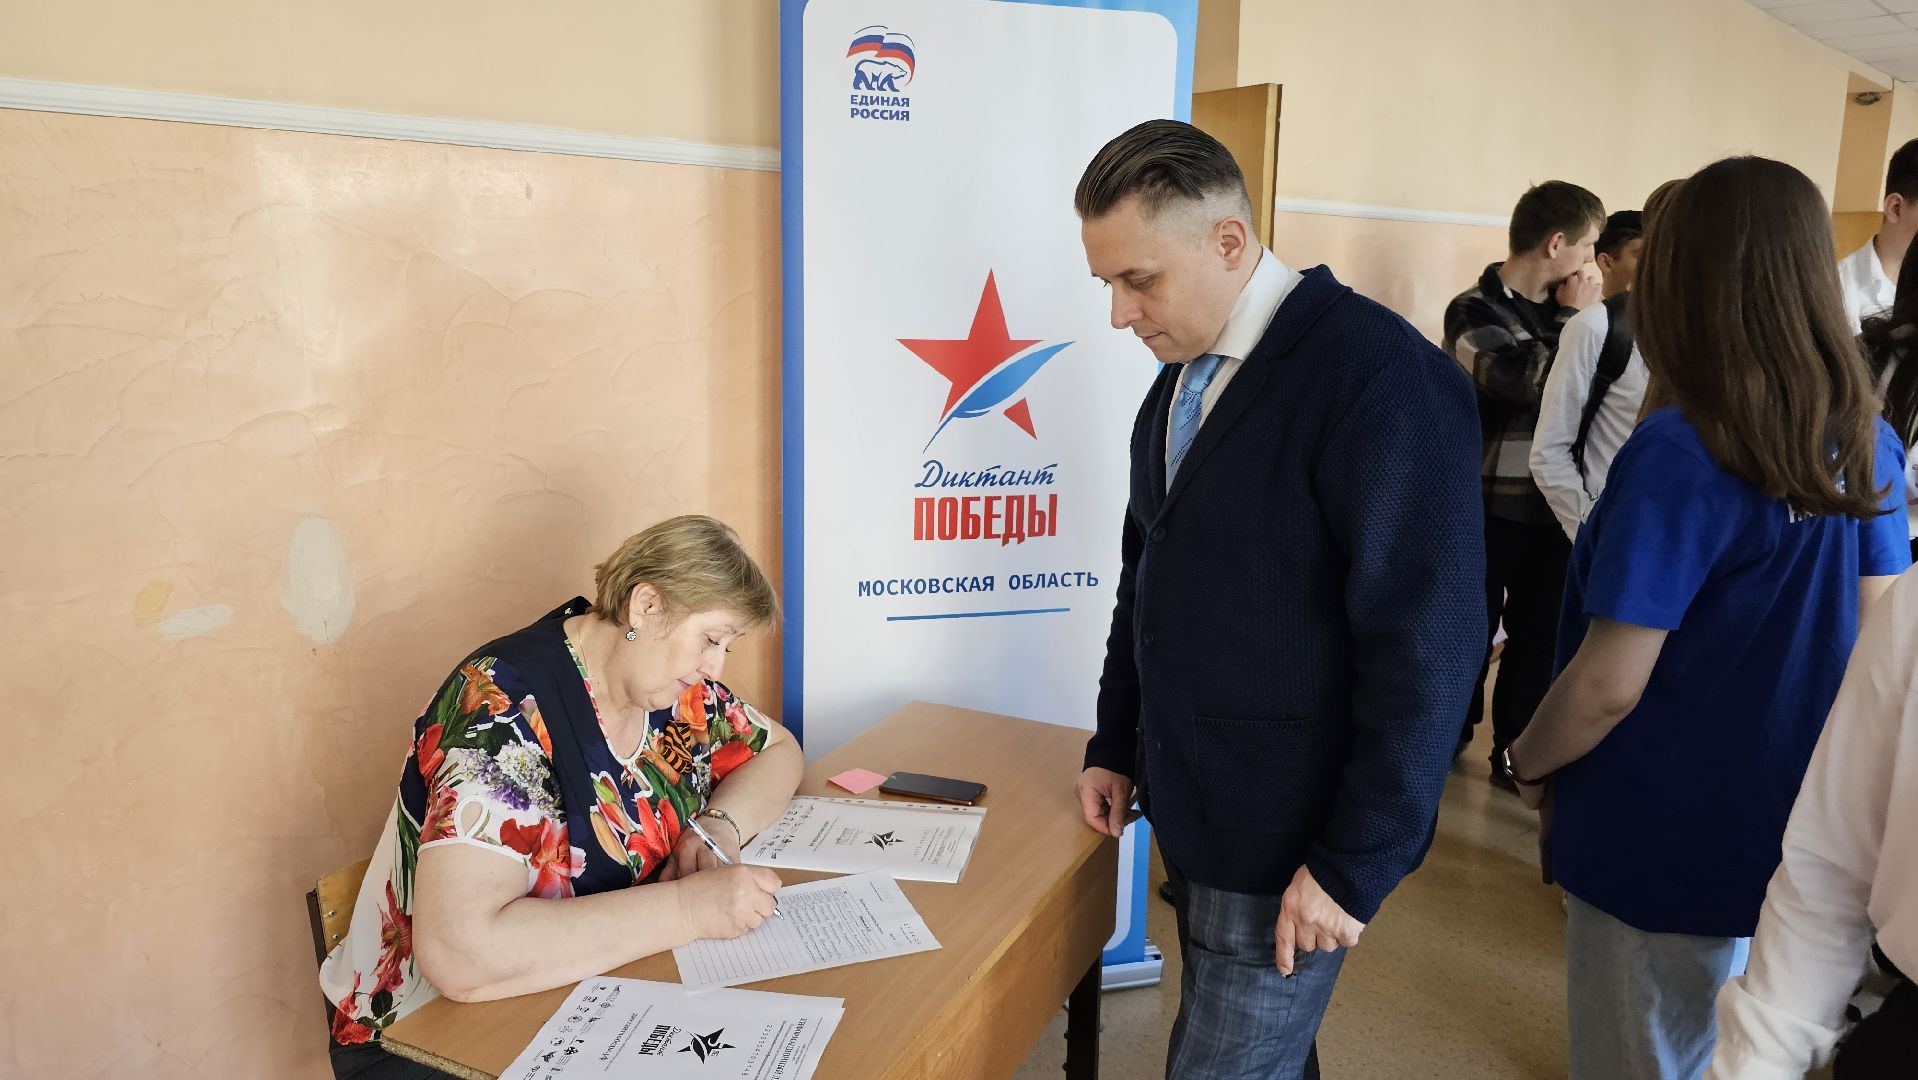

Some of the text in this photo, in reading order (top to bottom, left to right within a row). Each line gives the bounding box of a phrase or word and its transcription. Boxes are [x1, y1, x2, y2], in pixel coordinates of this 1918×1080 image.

[850, 94, 910, 107] ЕДИНАЯ
[850, 107, 910, 122] РОССИЯ
[914, 459, 1058, 488] Диктант
[913, 493, 1058, 547] ПОБЕДЫ
[858, 571, 1099, 597] МОСКОВСКАЯ ОБЛАСТЬ
[638, 1024, 671, 1056] ПОБЕДЫ
